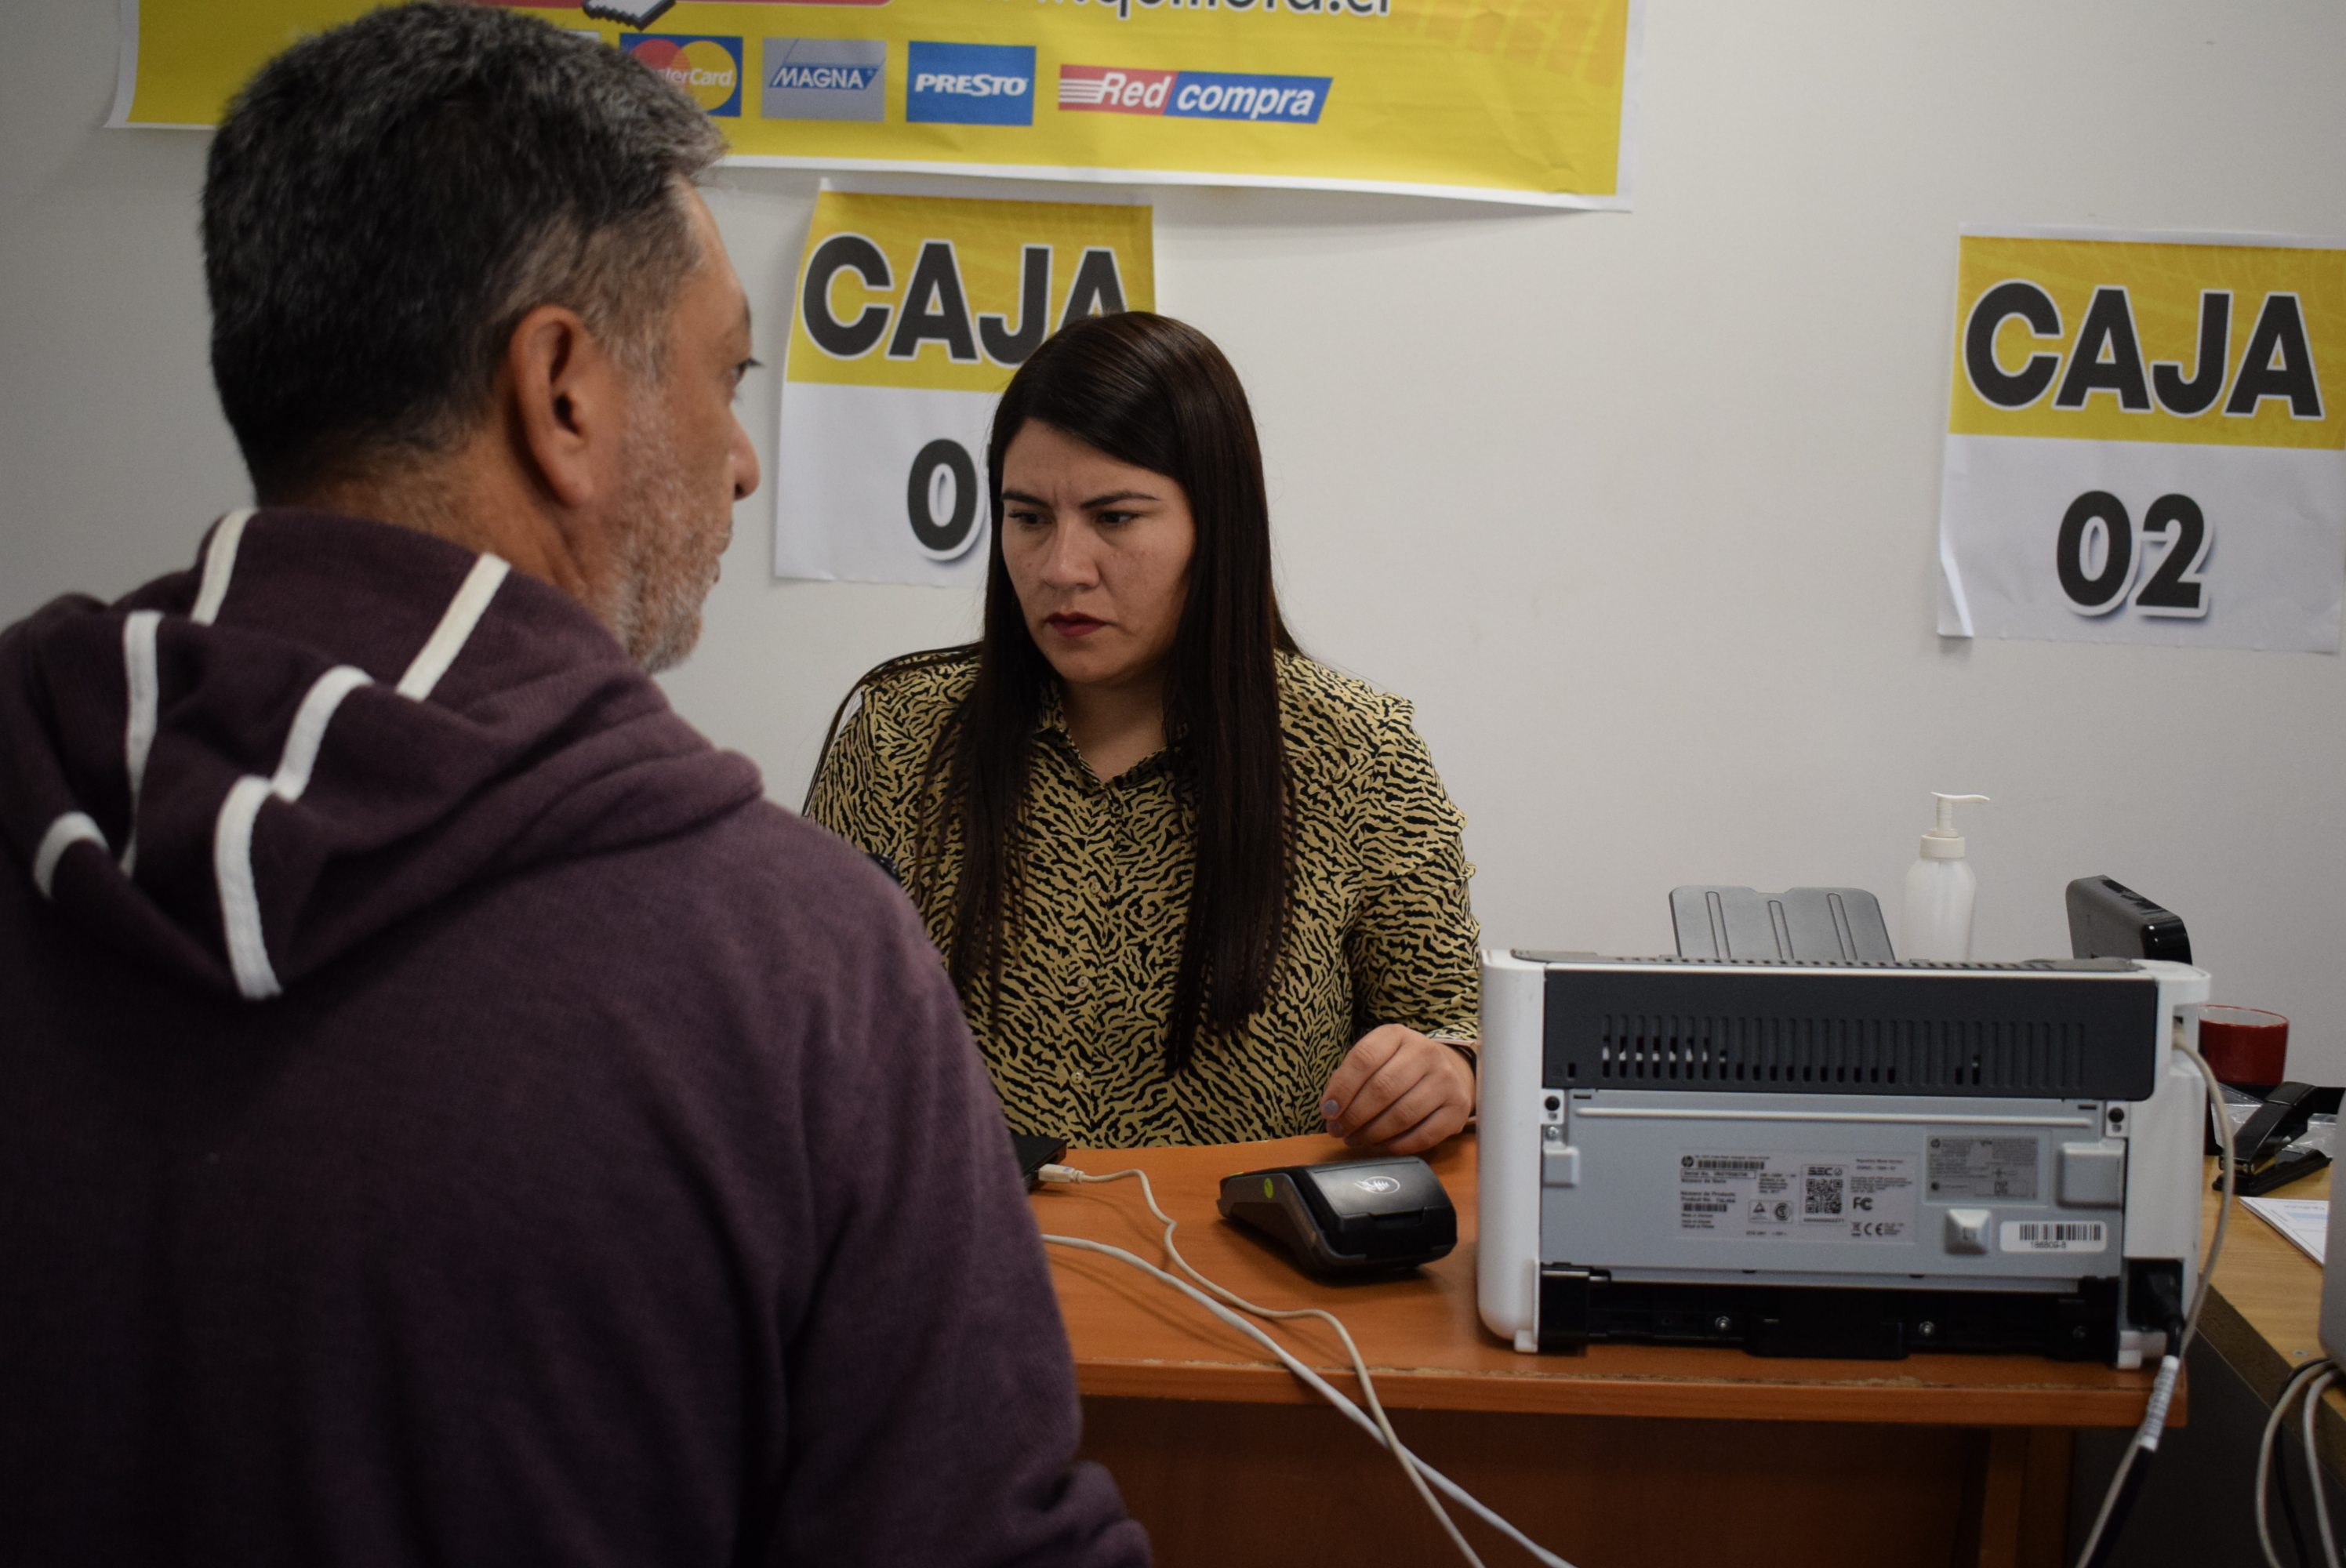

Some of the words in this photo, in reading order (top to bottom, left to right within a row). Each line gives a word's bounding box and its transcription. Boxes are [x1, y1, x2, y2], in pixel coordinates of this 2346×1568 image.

[772, 67, 865, 89] MAGNA
[1097, 71, 1171, 109] Red
[1176, 83, 1316, 120] compra
[1965, 281, 2324, 419] CAJA
[906, 437, 990, 552] 0
[2056, 490, 2206, 610] 02
